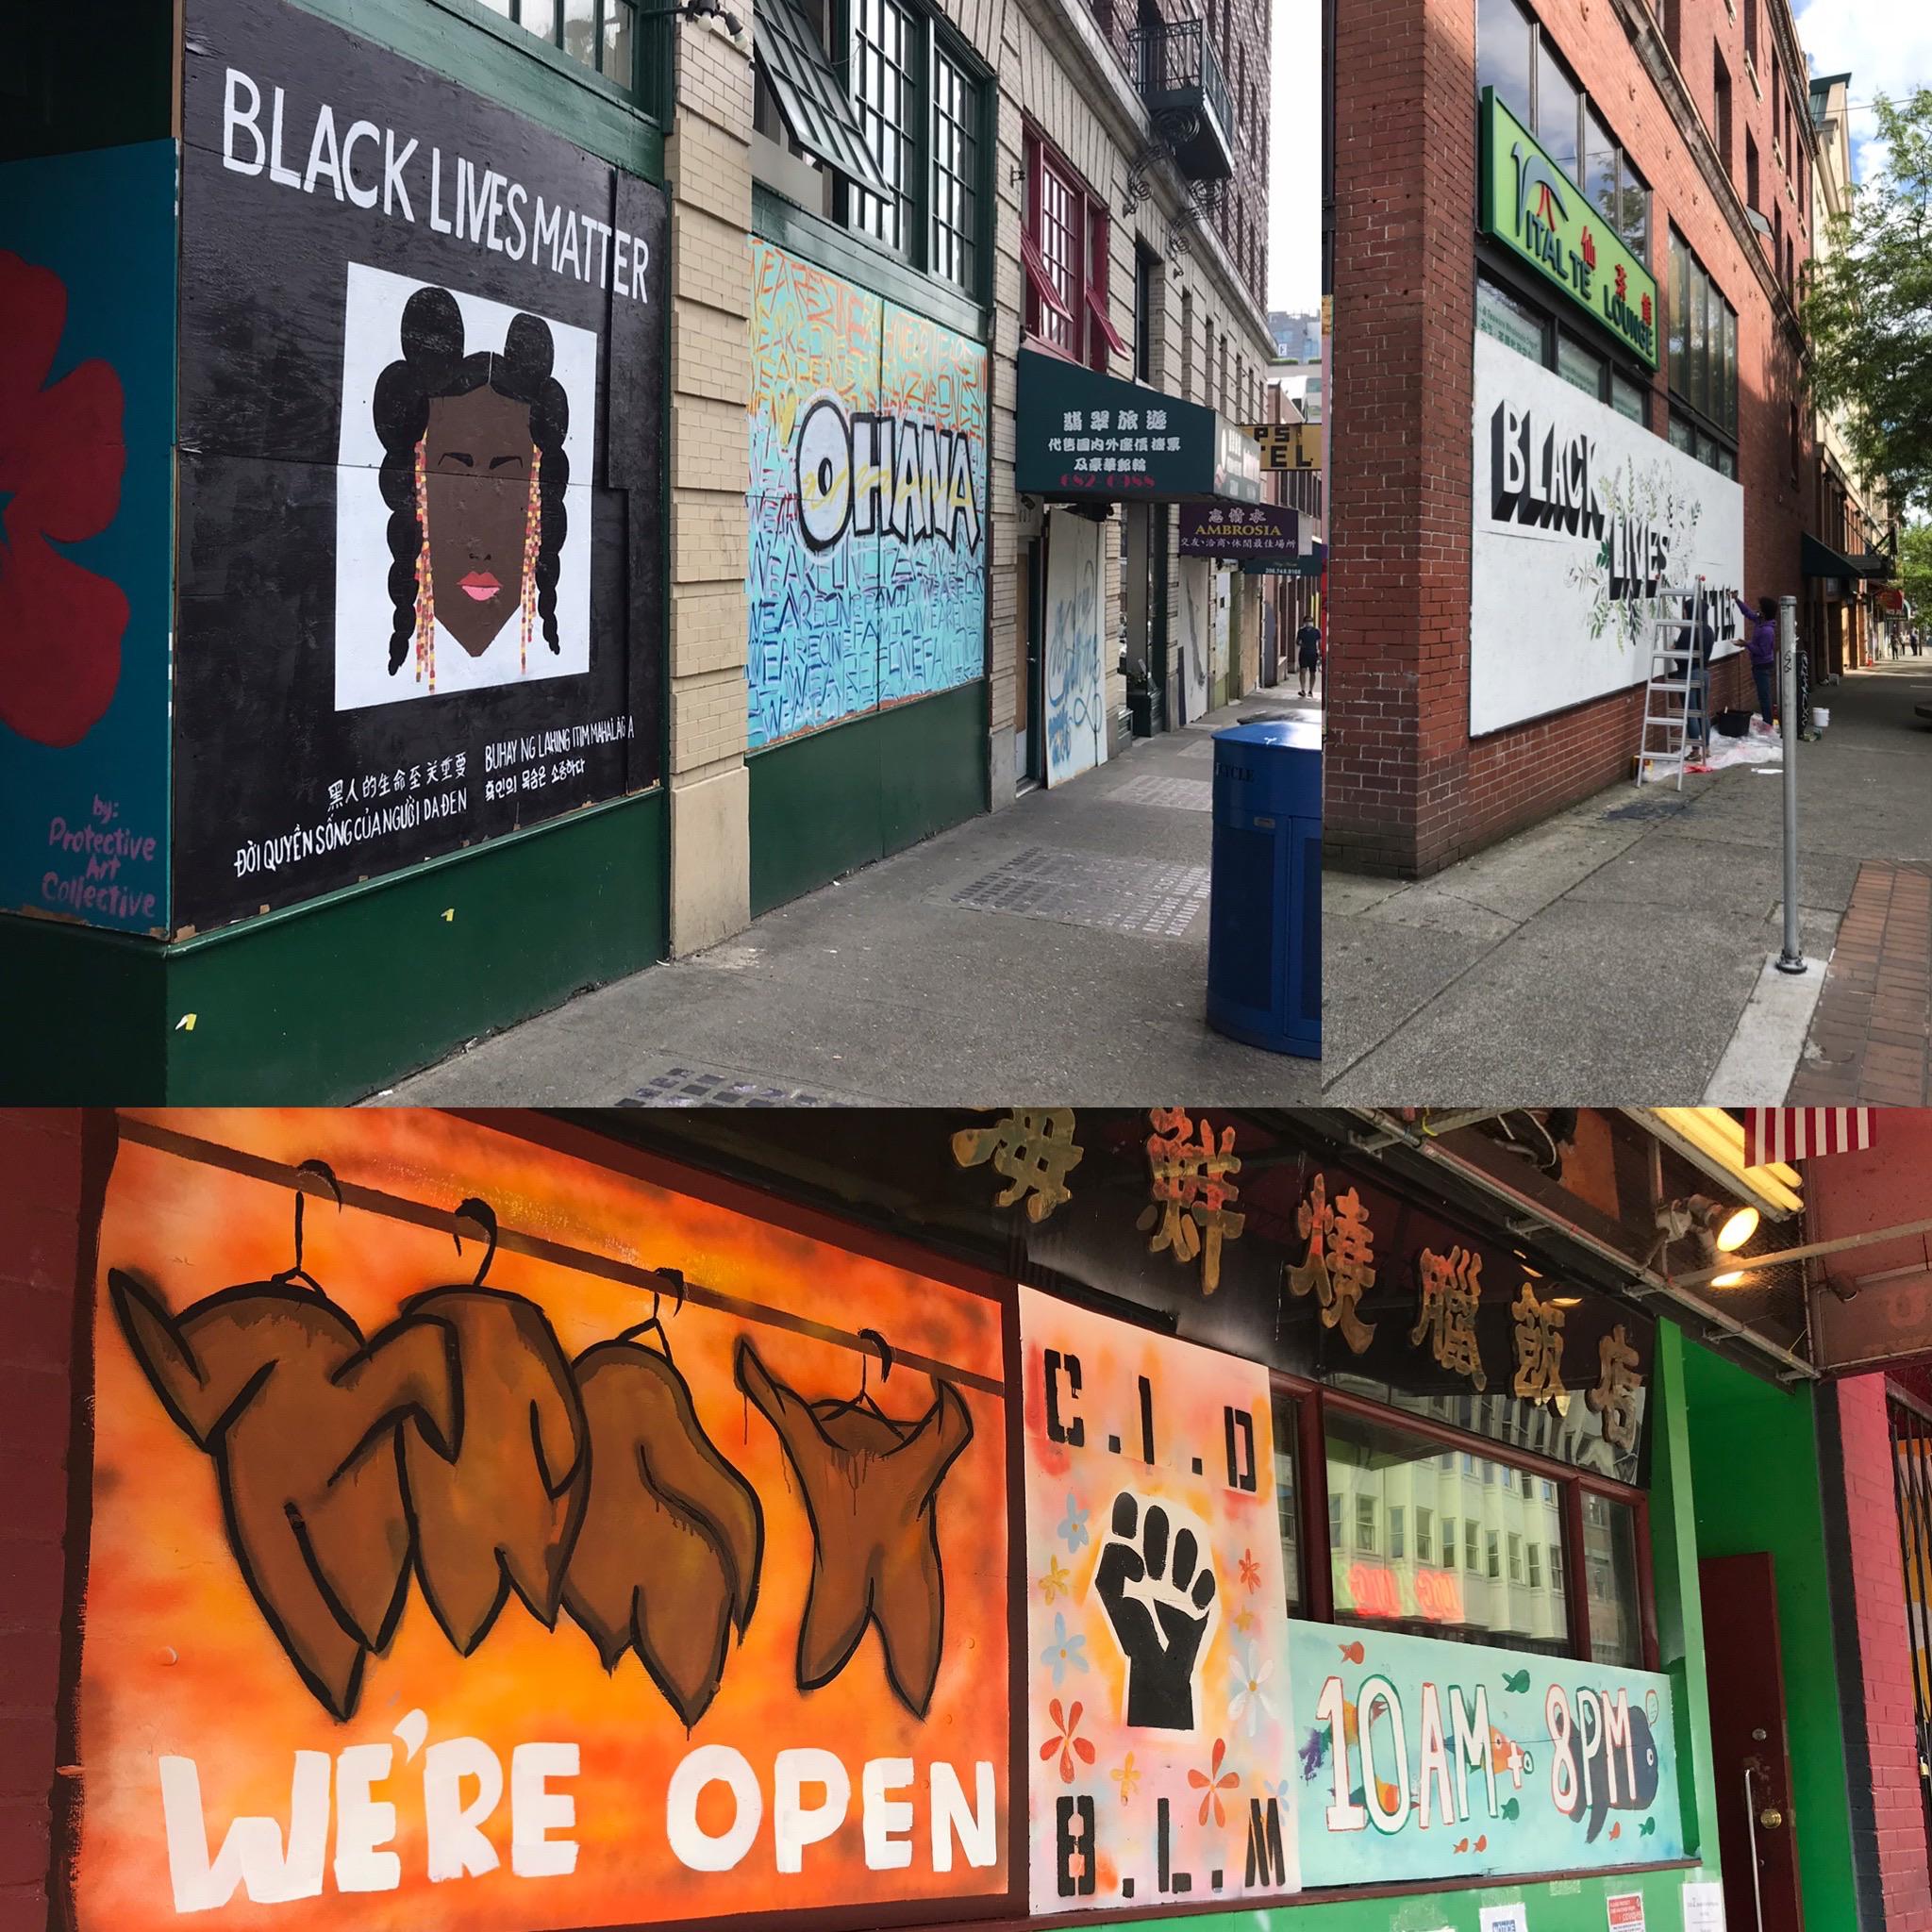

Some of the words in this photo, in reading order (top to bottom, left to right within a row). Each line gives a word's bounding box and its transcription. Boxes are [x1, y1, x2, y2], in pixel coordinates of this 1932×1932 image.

[223, 67, 419, 223] BLACK
[430, 147, 527, 261] LIVES
[532, 195, 650, 304] MATTER
[1604, 284, 1654, 358] LOUNGE
[1491, 399, 1606, 541] BLACK
[1194, 525, 1282, 536] AMBROSIA
[1608, 514, 1669, 601] LIVES
[485, 740, 518, 773] BUHAY
[521, 736, 536, 762] NG
[538, 726, 571, 758] LAHING
[92, 794, 119, 824] by:
[424, 796, 440, 821] DA
[441, 787, 467, 817] ĐEN
[49, 817, 157, 861] Protective
[86, 855, 121, 880] Art
[42, 872, 156, 918] Collective
[1507, 1740, 1534, 1789] to
[1545, 1683, 1637, 1816] 8PM
[158, 1708, 580, 1914] WE'RE
[665, 1743, 997, 1874] OPEN
